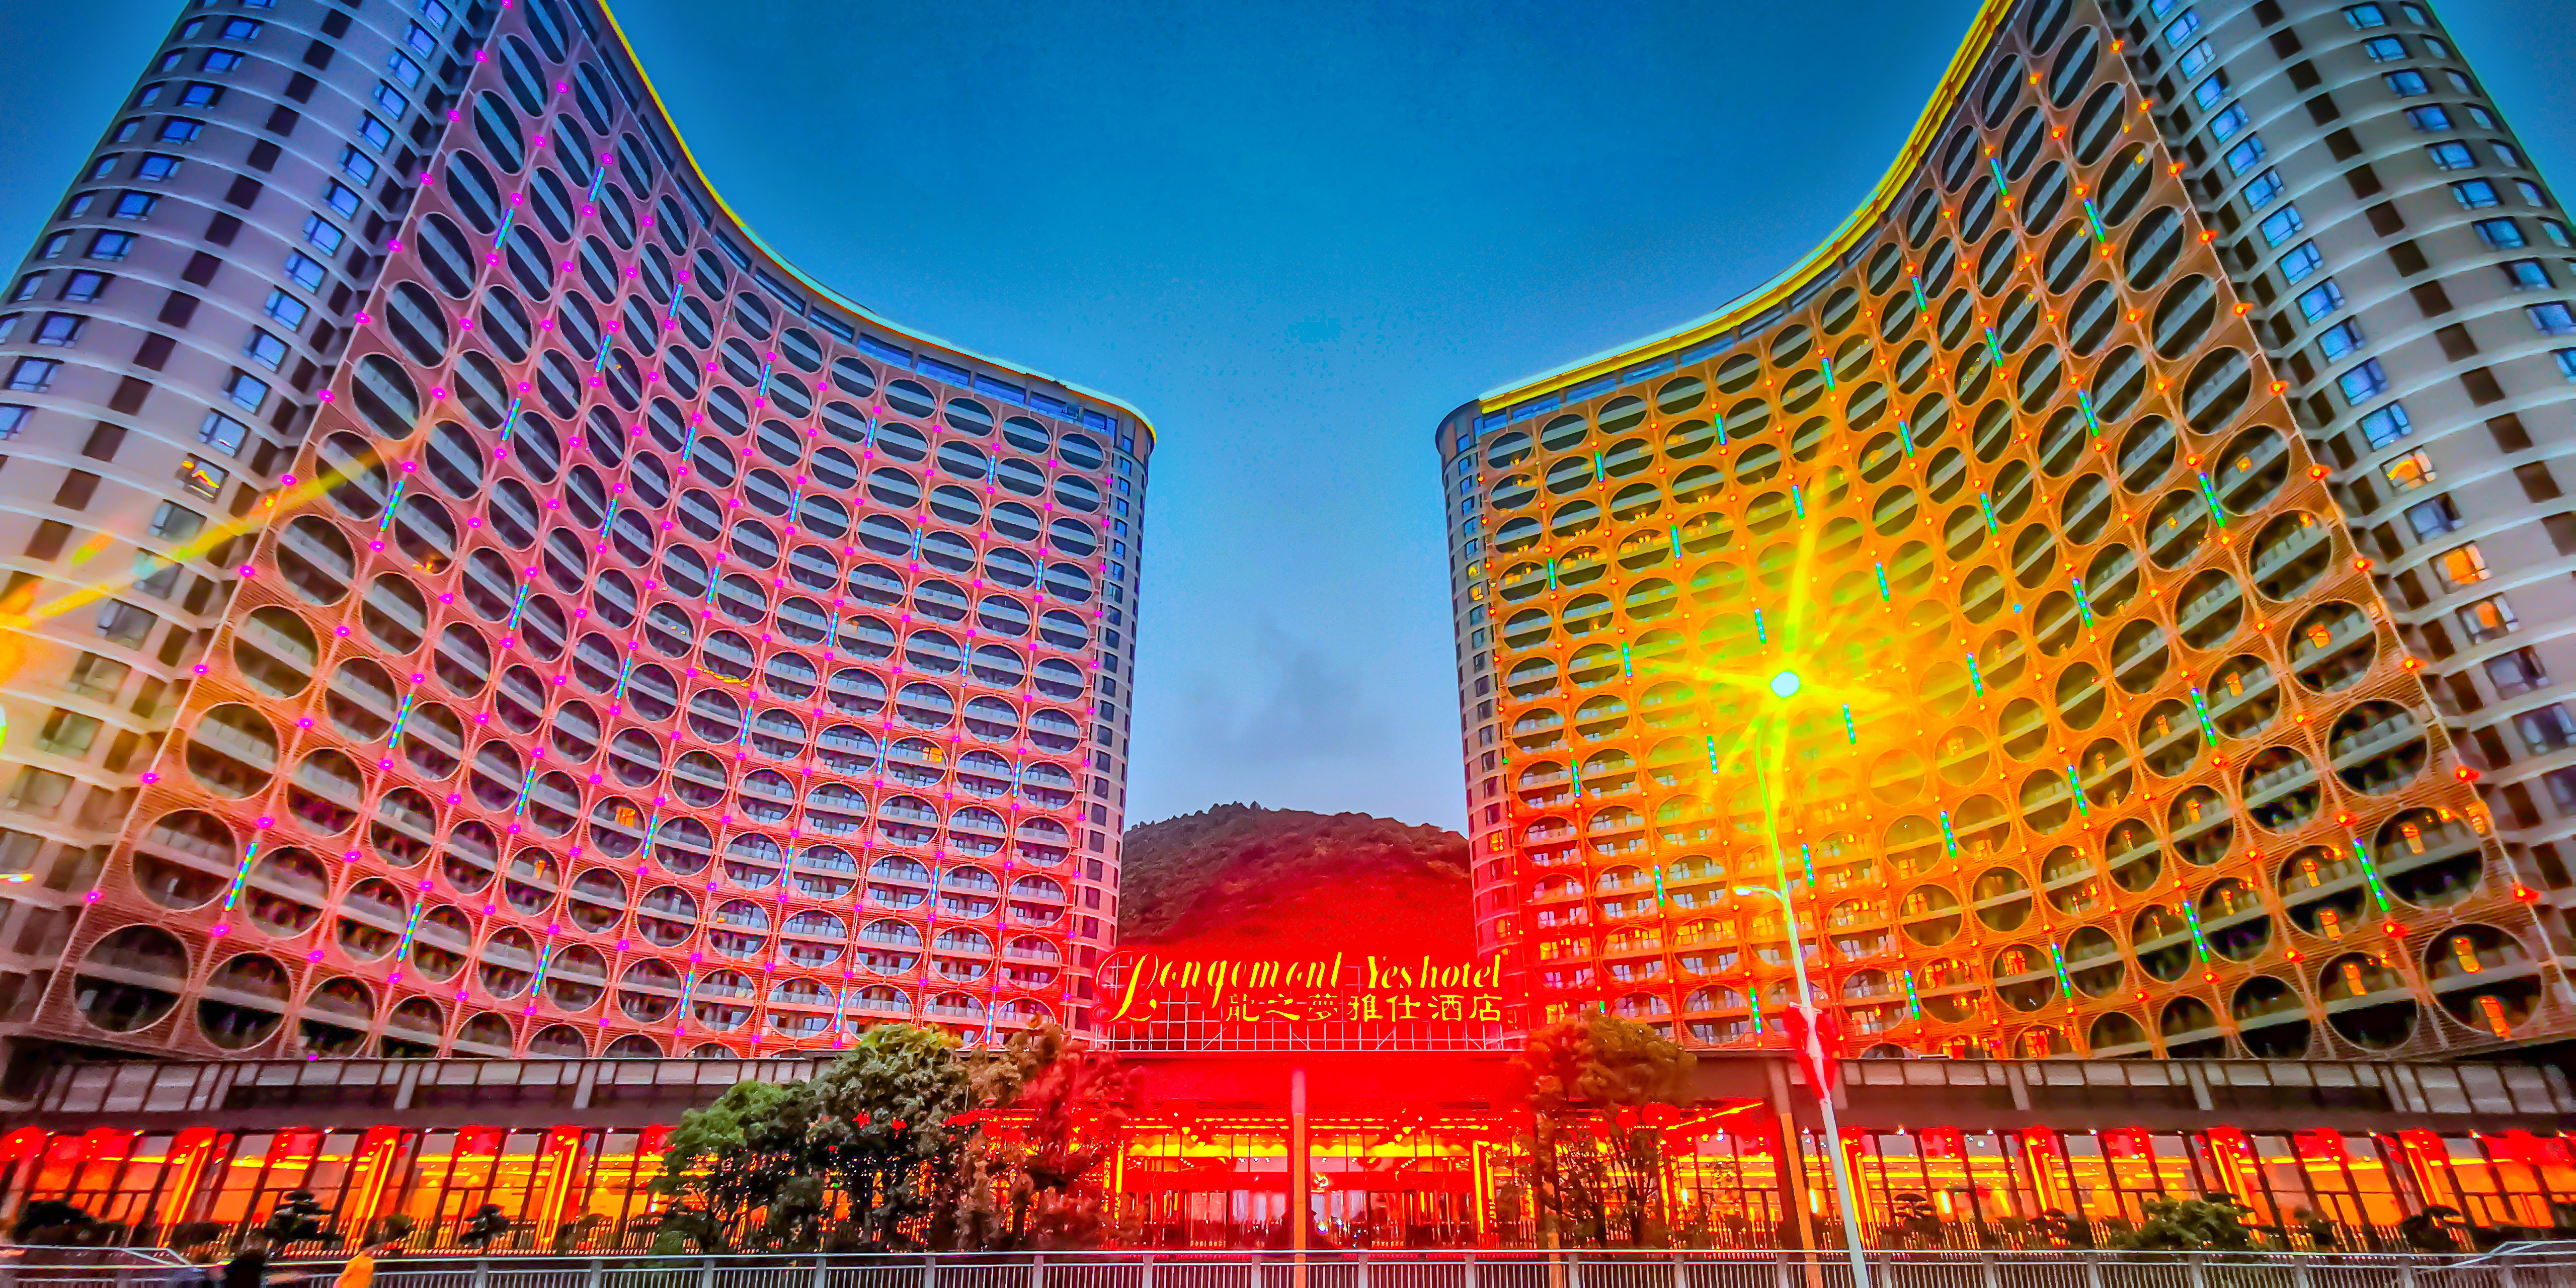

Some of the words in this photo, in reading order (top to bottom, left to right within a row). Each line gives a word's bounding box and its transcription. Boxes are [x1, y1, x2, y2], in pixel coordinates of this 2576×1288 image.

[1093, 950, 1342, 1022] Longemont
[1225, 993, 1503, 1022] 龍之夢雅仕酒店
